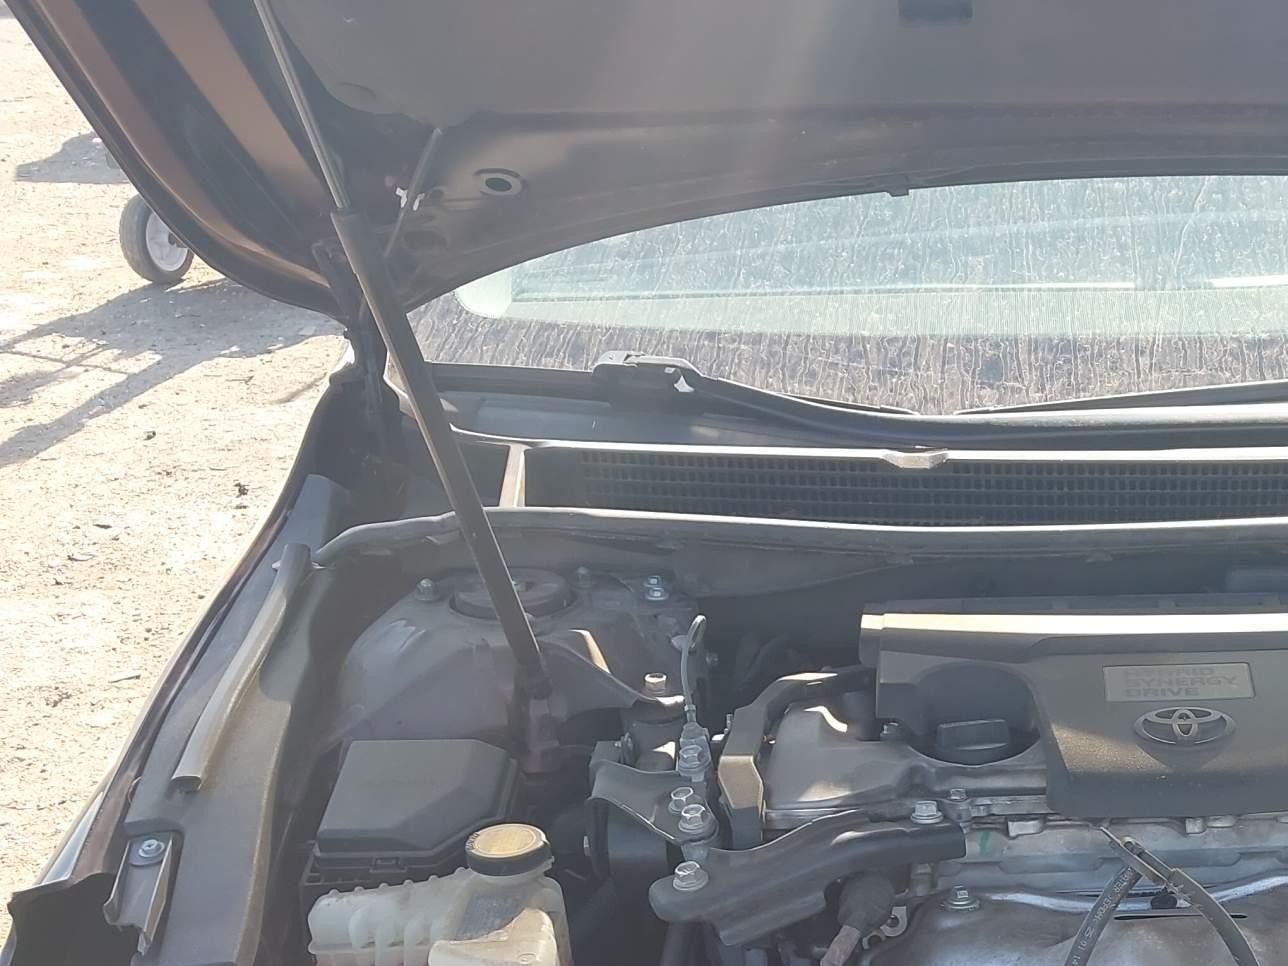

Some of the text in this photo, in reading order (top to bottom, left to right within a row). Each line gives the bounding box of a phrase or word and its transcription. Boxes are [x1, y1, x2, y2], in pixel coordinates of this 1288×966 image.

[1126, 666, 1215, 677] RID
[1125, 675, 1237, 688] SYNERGY
[1125, 687, 1201, 698] DRIVE
